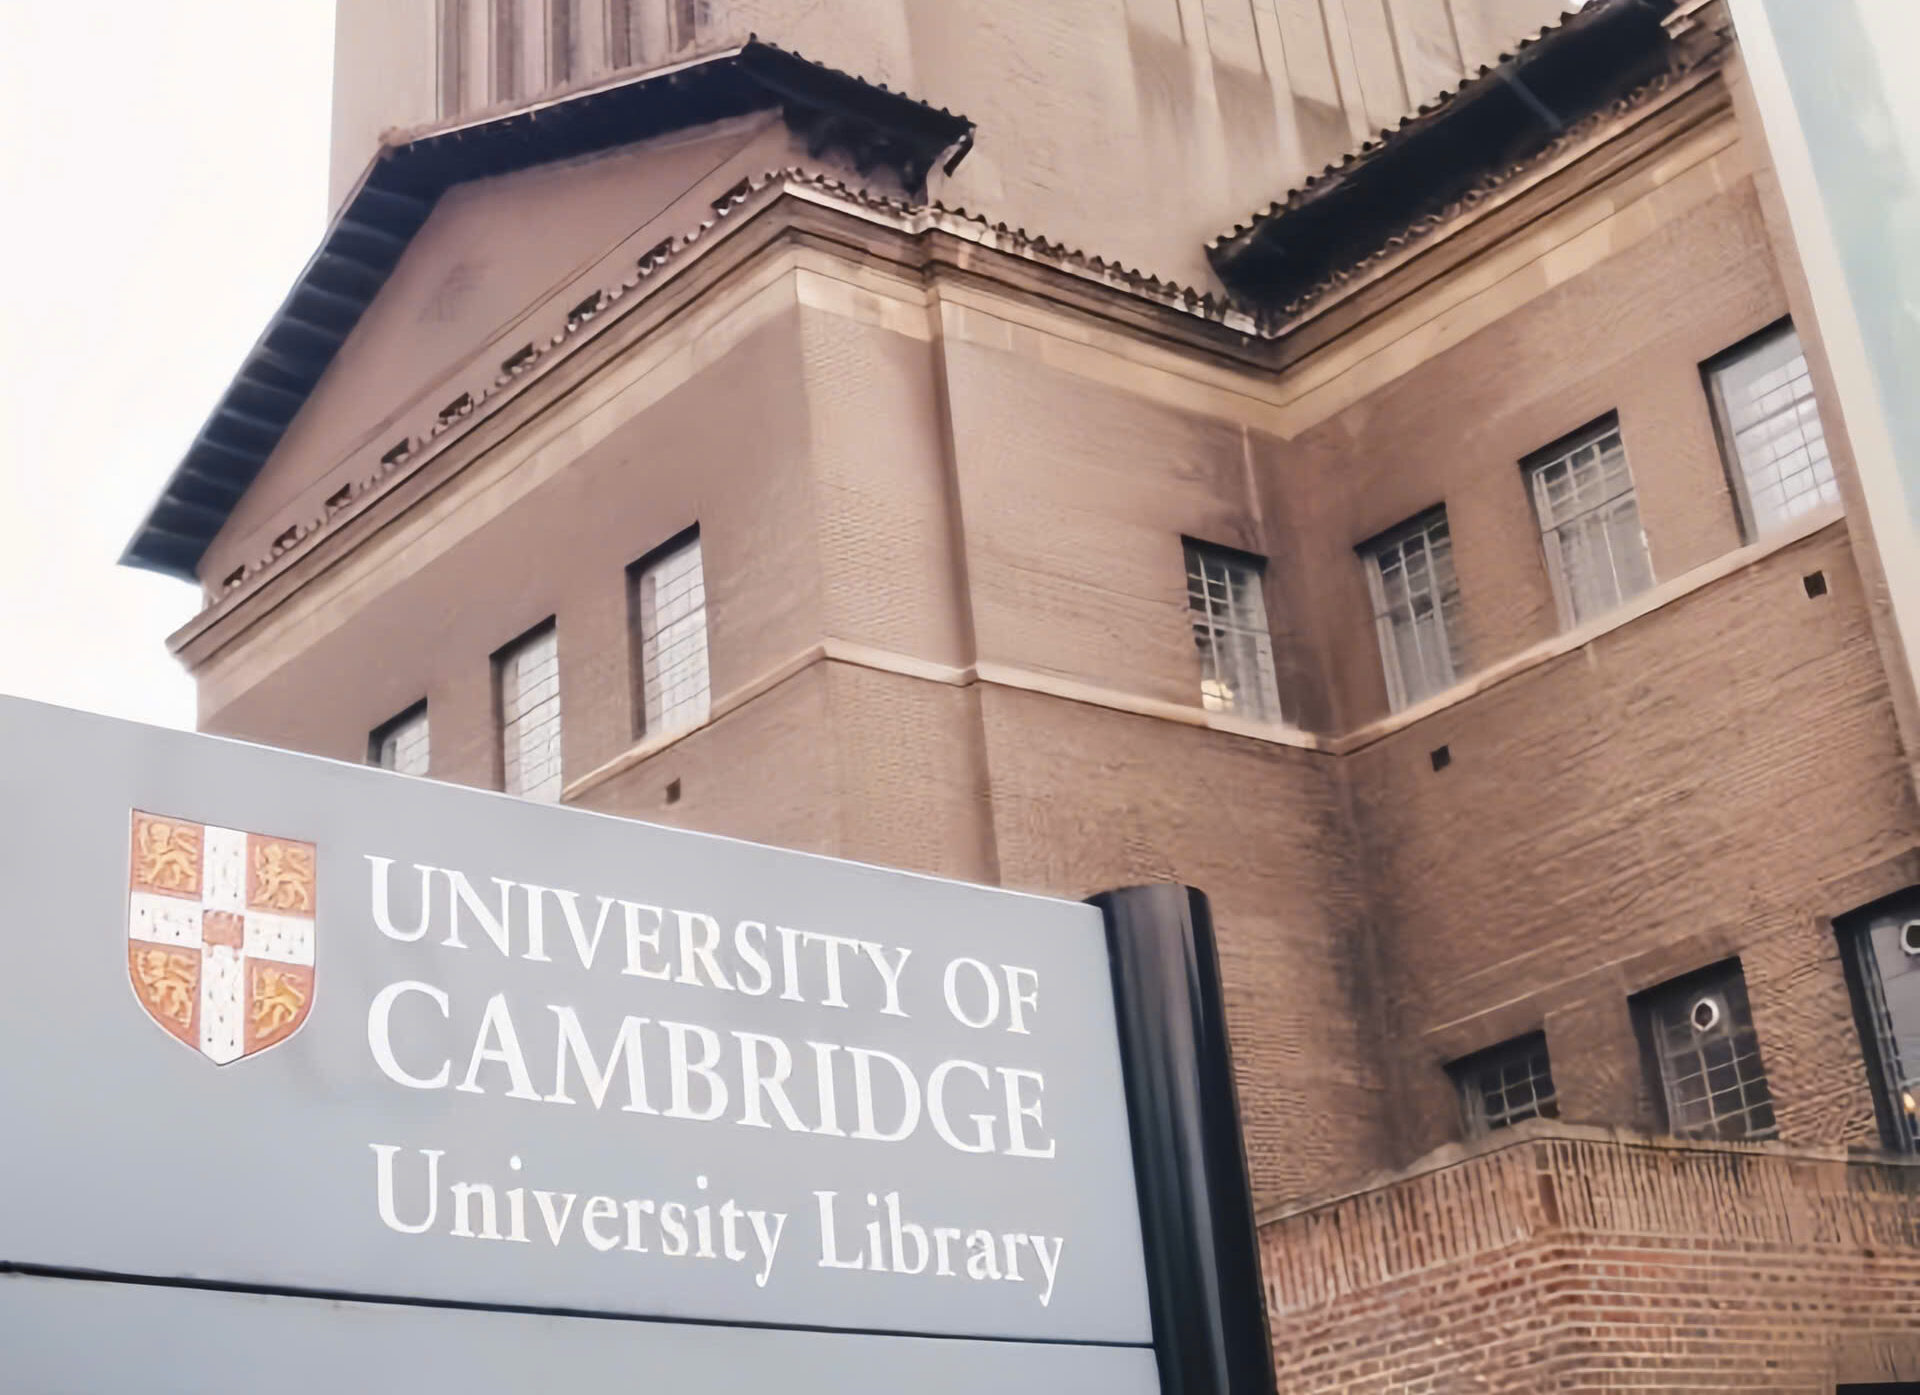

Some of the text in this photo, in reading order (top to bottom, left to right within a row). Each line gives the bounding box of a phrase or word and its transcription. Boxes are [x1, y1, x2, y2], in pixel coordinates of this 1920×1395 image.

[363, 854, 1040, 1035] UNIVERSITY OF
[367, 979, 1056, 1159] CAMBRIDGE
[369, 1143, 1064, 1308] University Library
